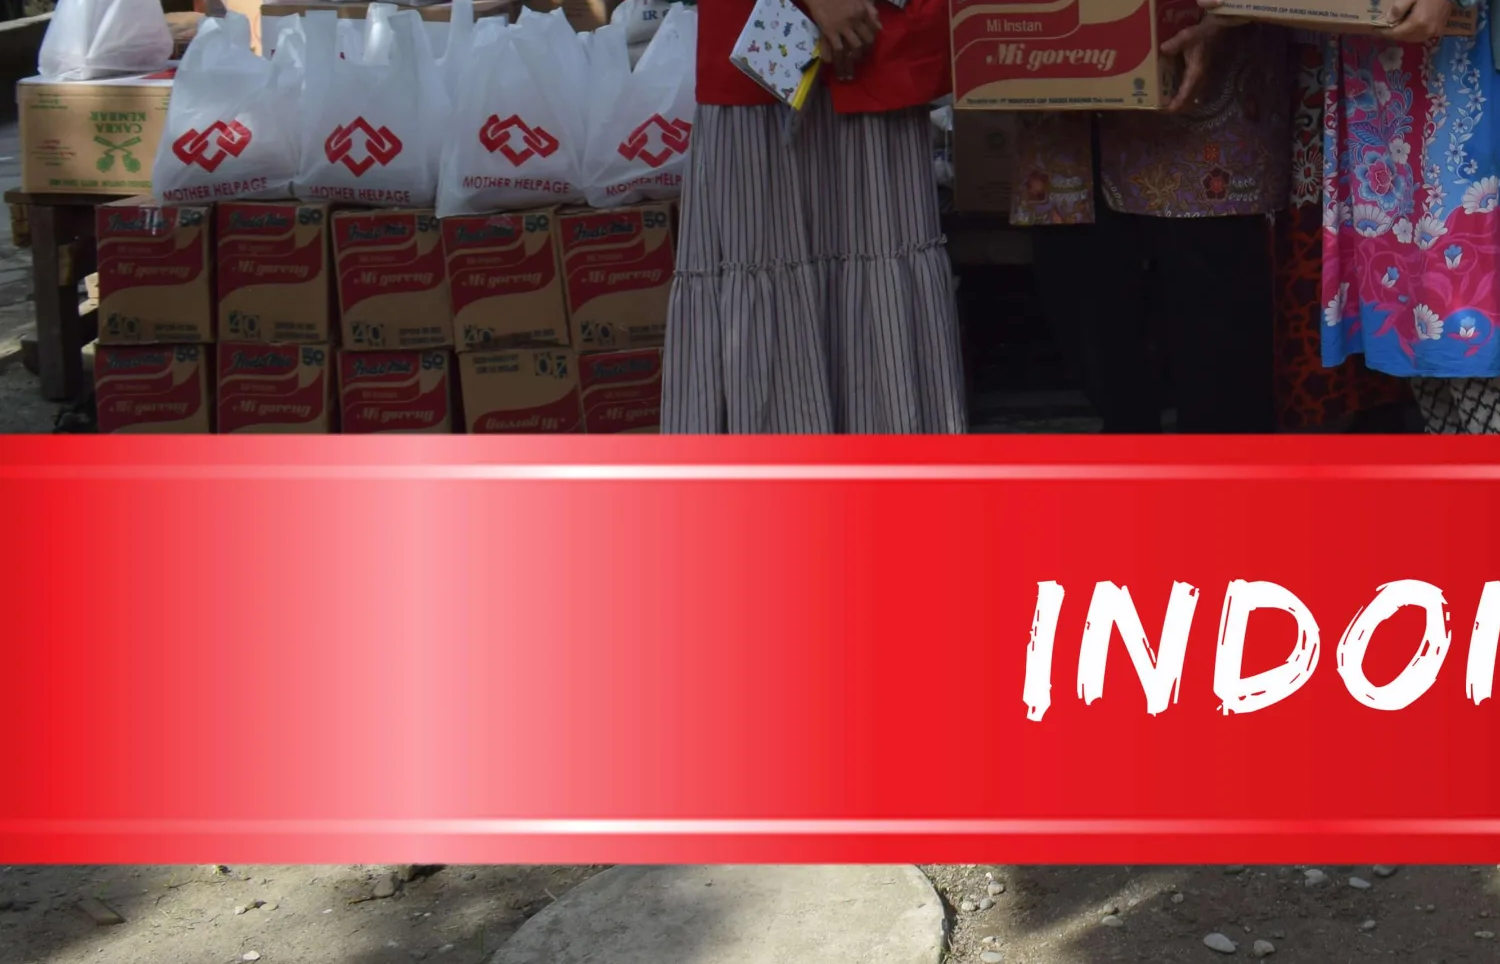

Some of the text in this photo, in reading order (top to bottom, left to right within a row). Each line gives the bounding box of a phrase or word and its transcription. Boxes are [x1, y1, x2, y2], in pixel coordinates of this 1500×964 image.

[986, 19, 1042, 32] Mi Instan
[986, 43, 1117, 71] Mi goreng
[463, 176, 569, 194] MOTHER HELPAGE
[655, 172, 681, 186] HELP
[163, 177, 267, 202] MOTHER HELPAGE
[310, 186, 410, 203] MOTHER HELPAGE
